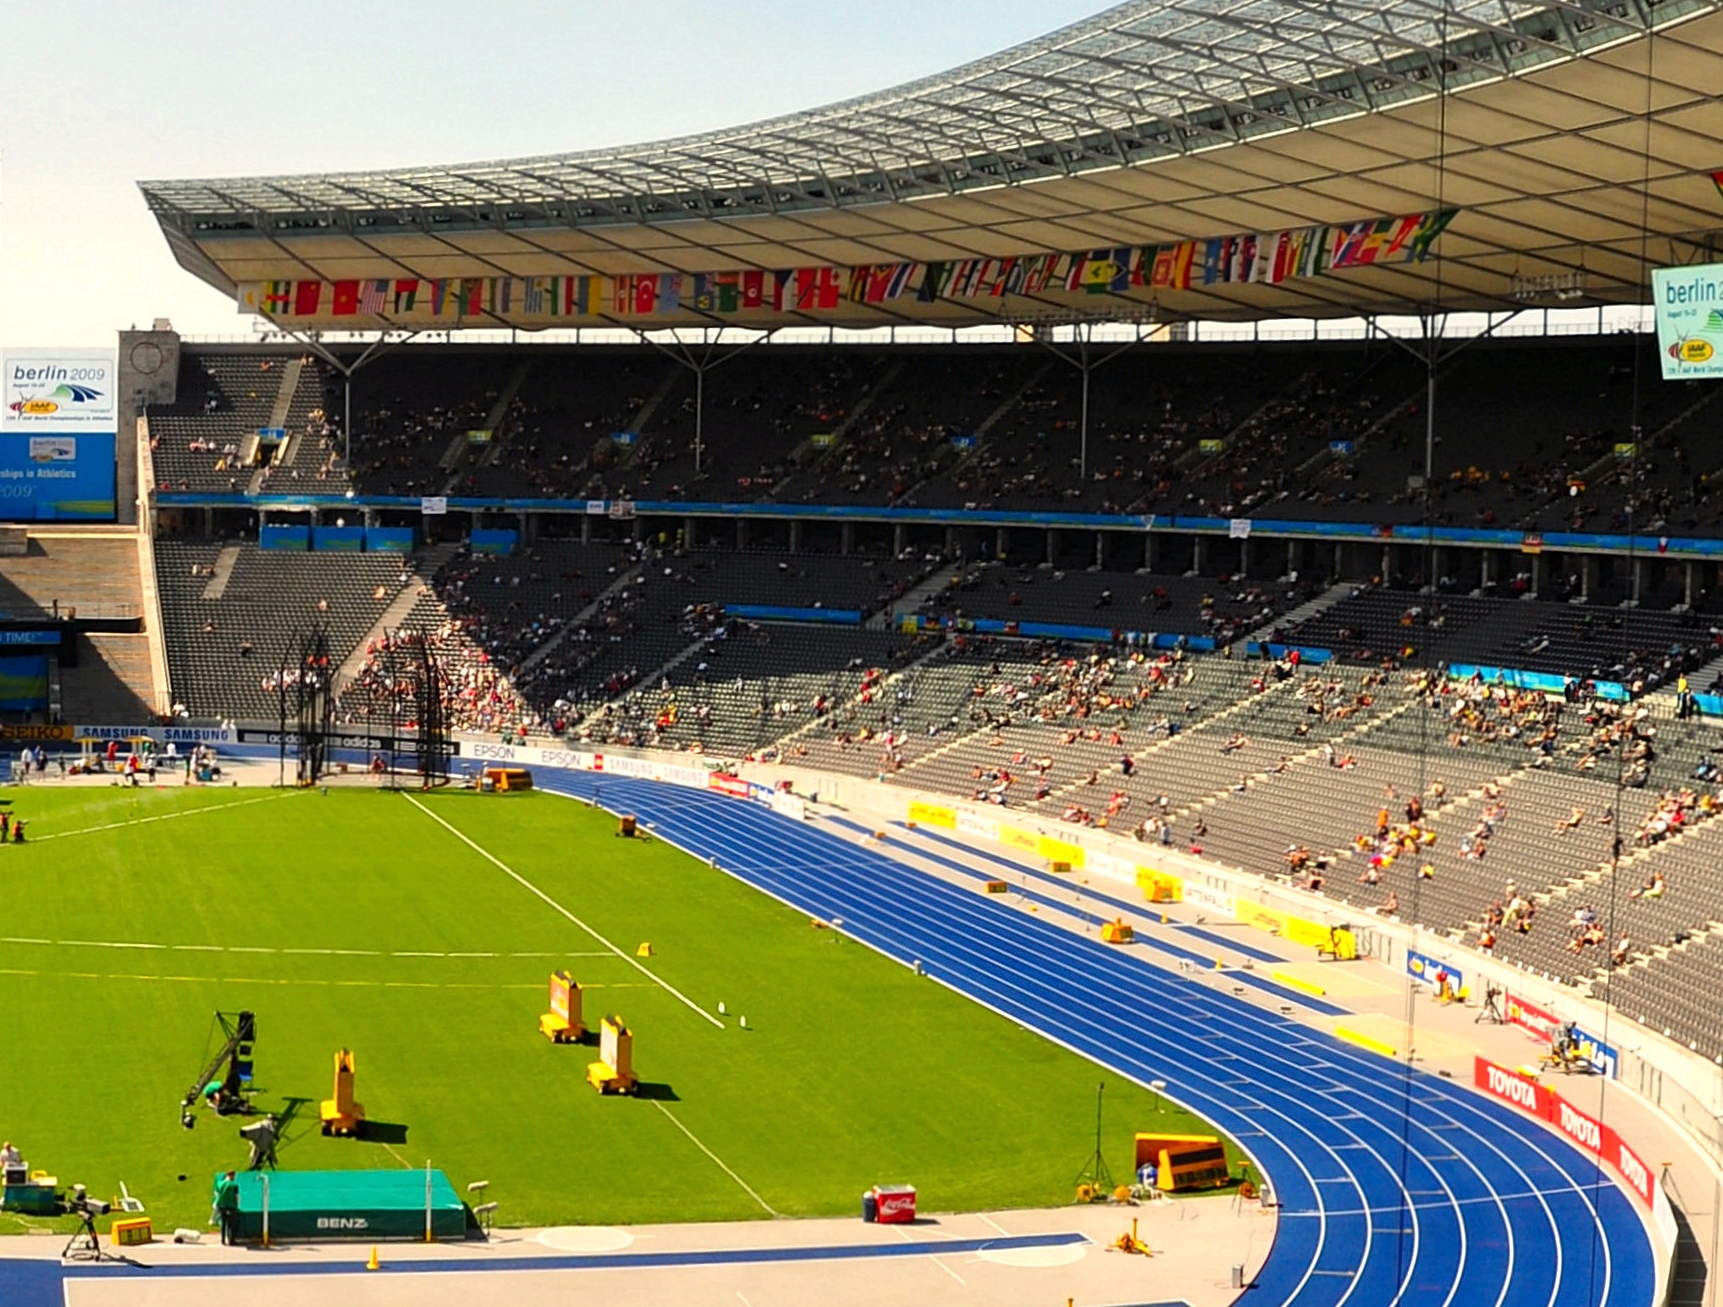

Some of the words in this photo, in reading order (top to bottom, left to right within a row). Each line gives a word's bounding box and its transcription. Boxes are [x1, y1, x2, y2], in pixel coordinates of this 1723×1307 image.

[1666, 277, 1715, 304] berlin
[13, 365, 67, 380] berlin
[70, 368, 105, 381] 2009
[27, 468, 34, 478] in
[36, 468, 76, 479] Athletics
[4, 725, 63, 738] SEIKO
[166, 729, 229, 741] SAMSUNG
[474, 744, 515, 759] EPSON
[541, 750, 581, 767] EPSON
[1487, 1065, 1537, 1110] TOYOTA
[1559, 1102, 1602, 1150] TOYOTA
[1620, 1144, 1648, 1199] TOYOTA
